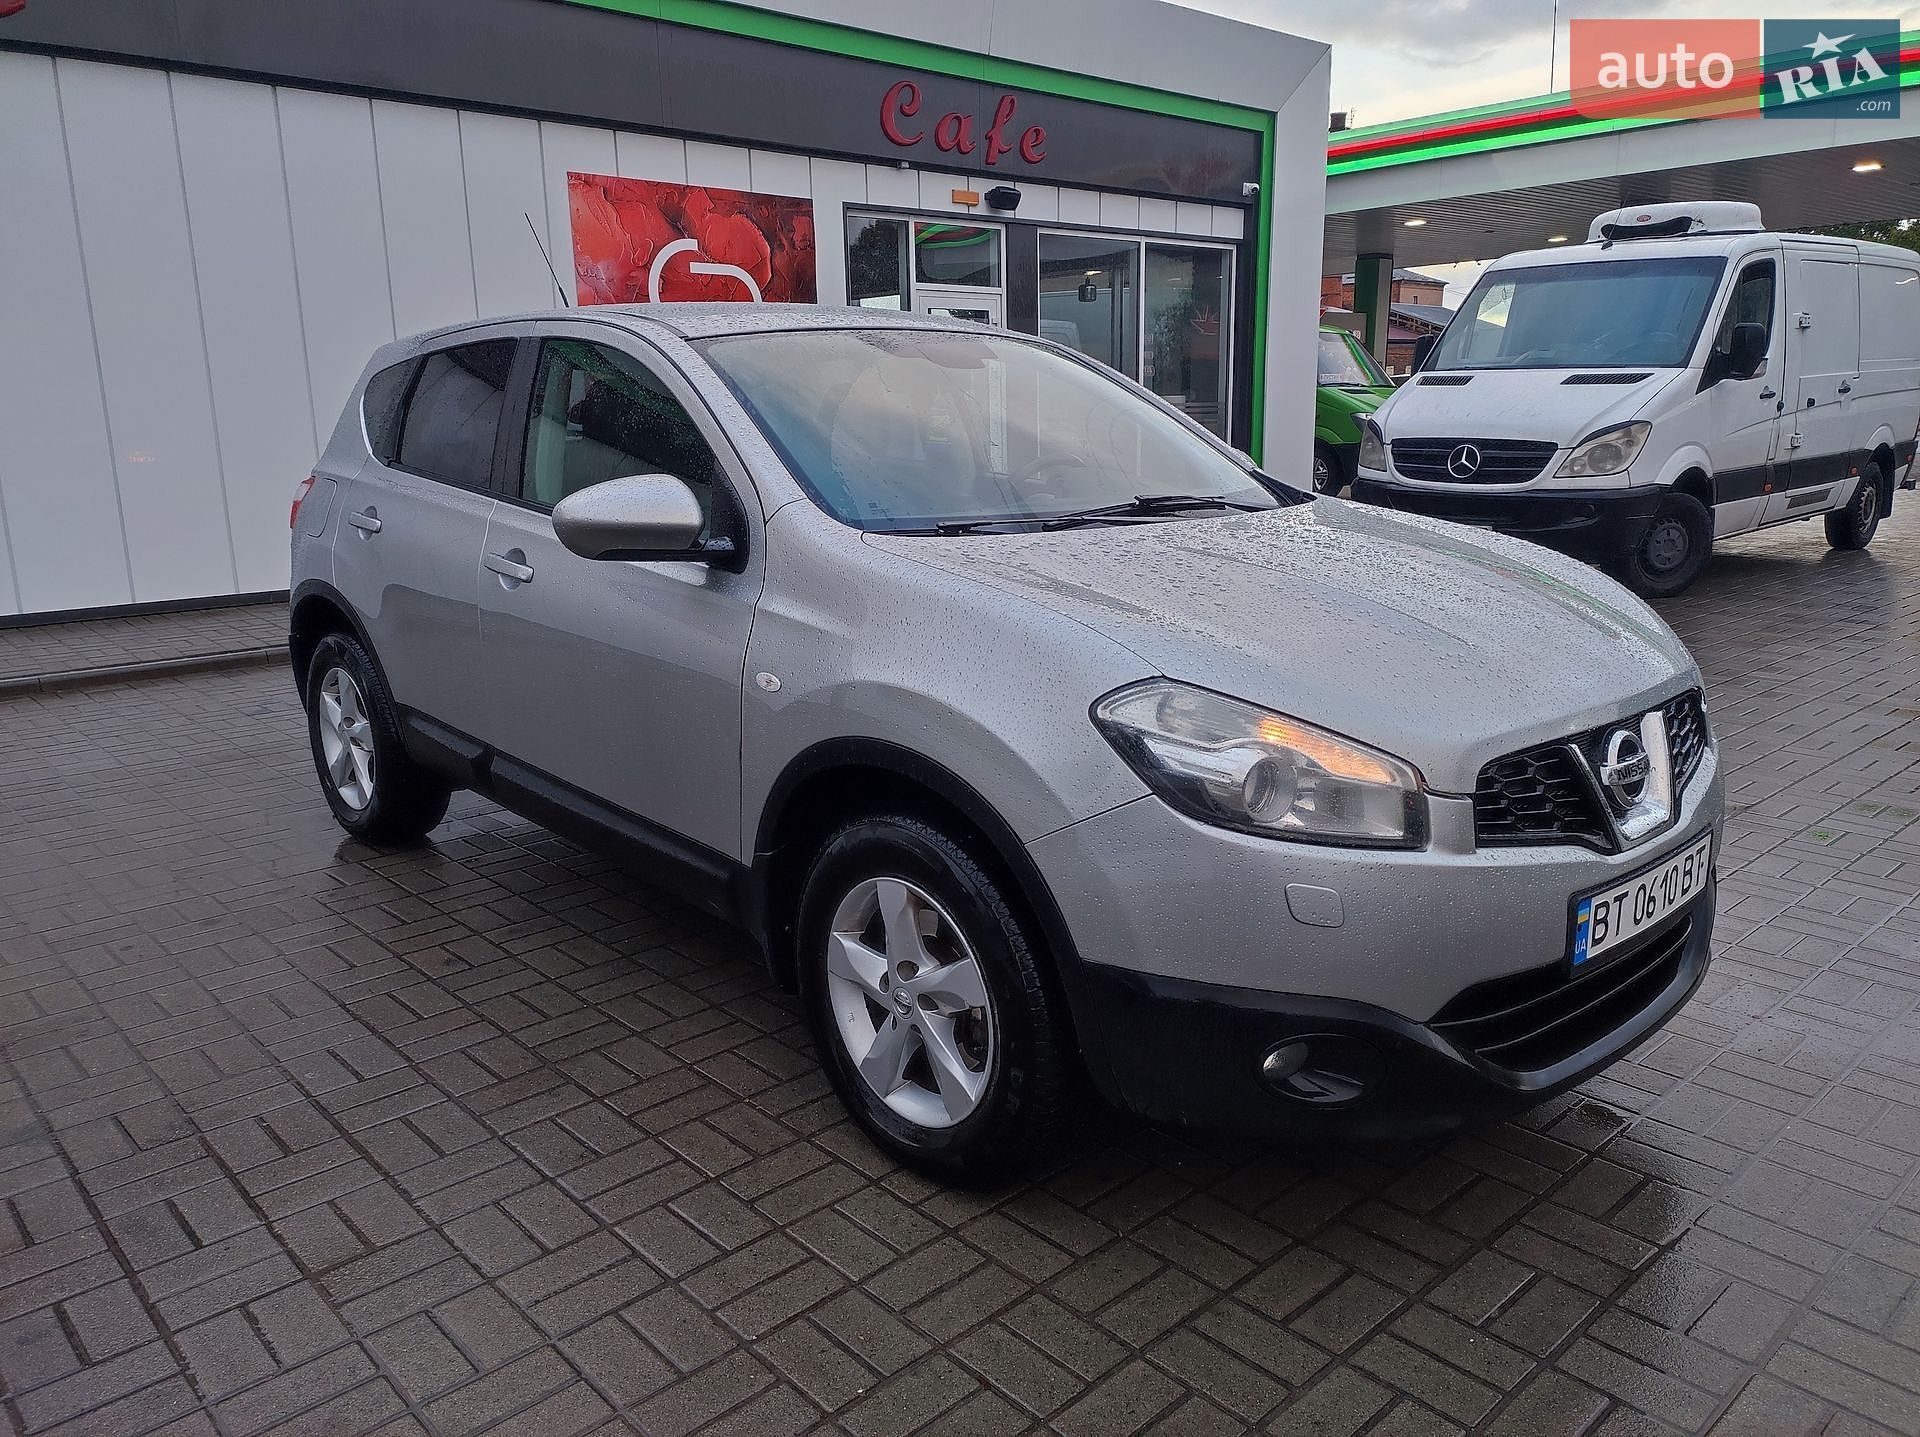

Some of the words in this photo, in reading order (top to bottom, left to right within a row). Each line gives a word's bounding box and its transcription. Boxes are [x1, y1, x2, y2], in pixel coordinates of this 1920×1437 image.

[880, 80, 1047, 164] Cafe
[1590, 890, 1630, 948] BT
[1633, 864, 1679, 926] 0610
[1681, 843, 1707, 898] BT
[1575, 941, 1586, 954] UA
